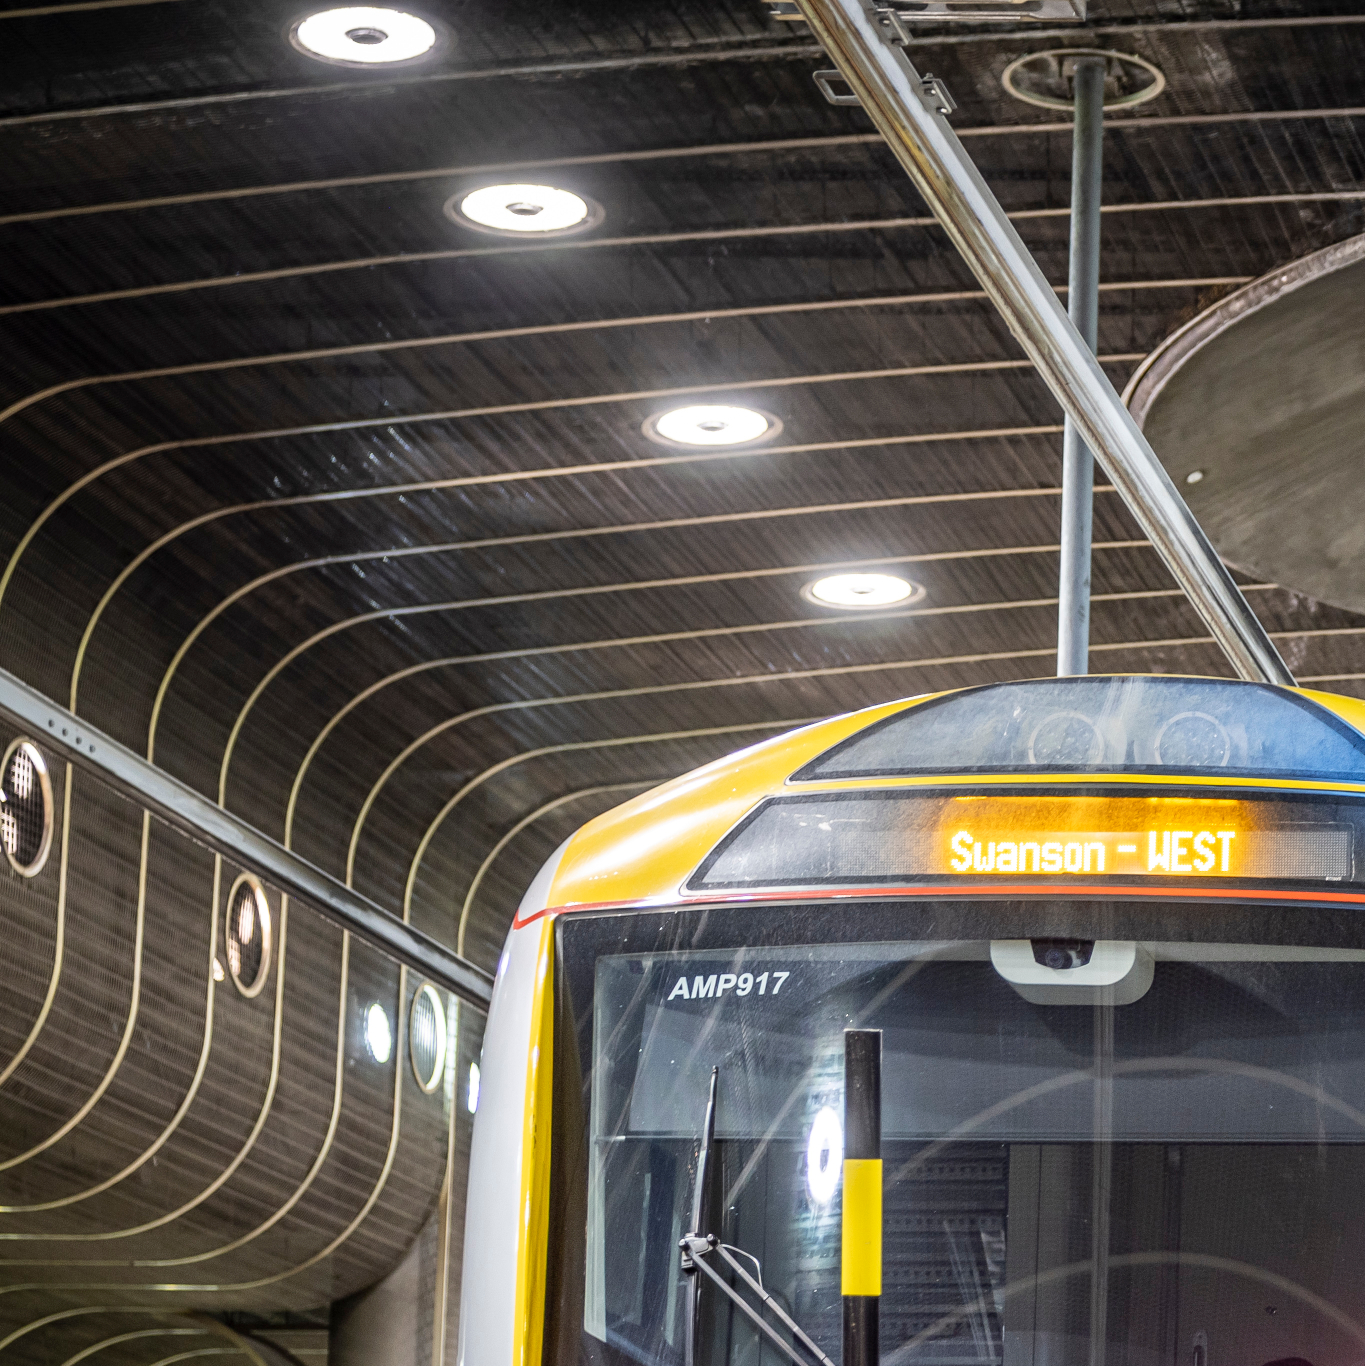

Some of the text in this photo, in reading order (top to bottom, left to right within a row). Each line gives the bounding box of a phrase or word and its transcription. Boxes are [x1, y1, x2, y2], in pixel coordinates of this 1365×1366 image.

[950, 830, 1106, 872] Swanson
[1148, 830, 1236, 872] WEST
[667, 971, 791, 1001] AMP917
